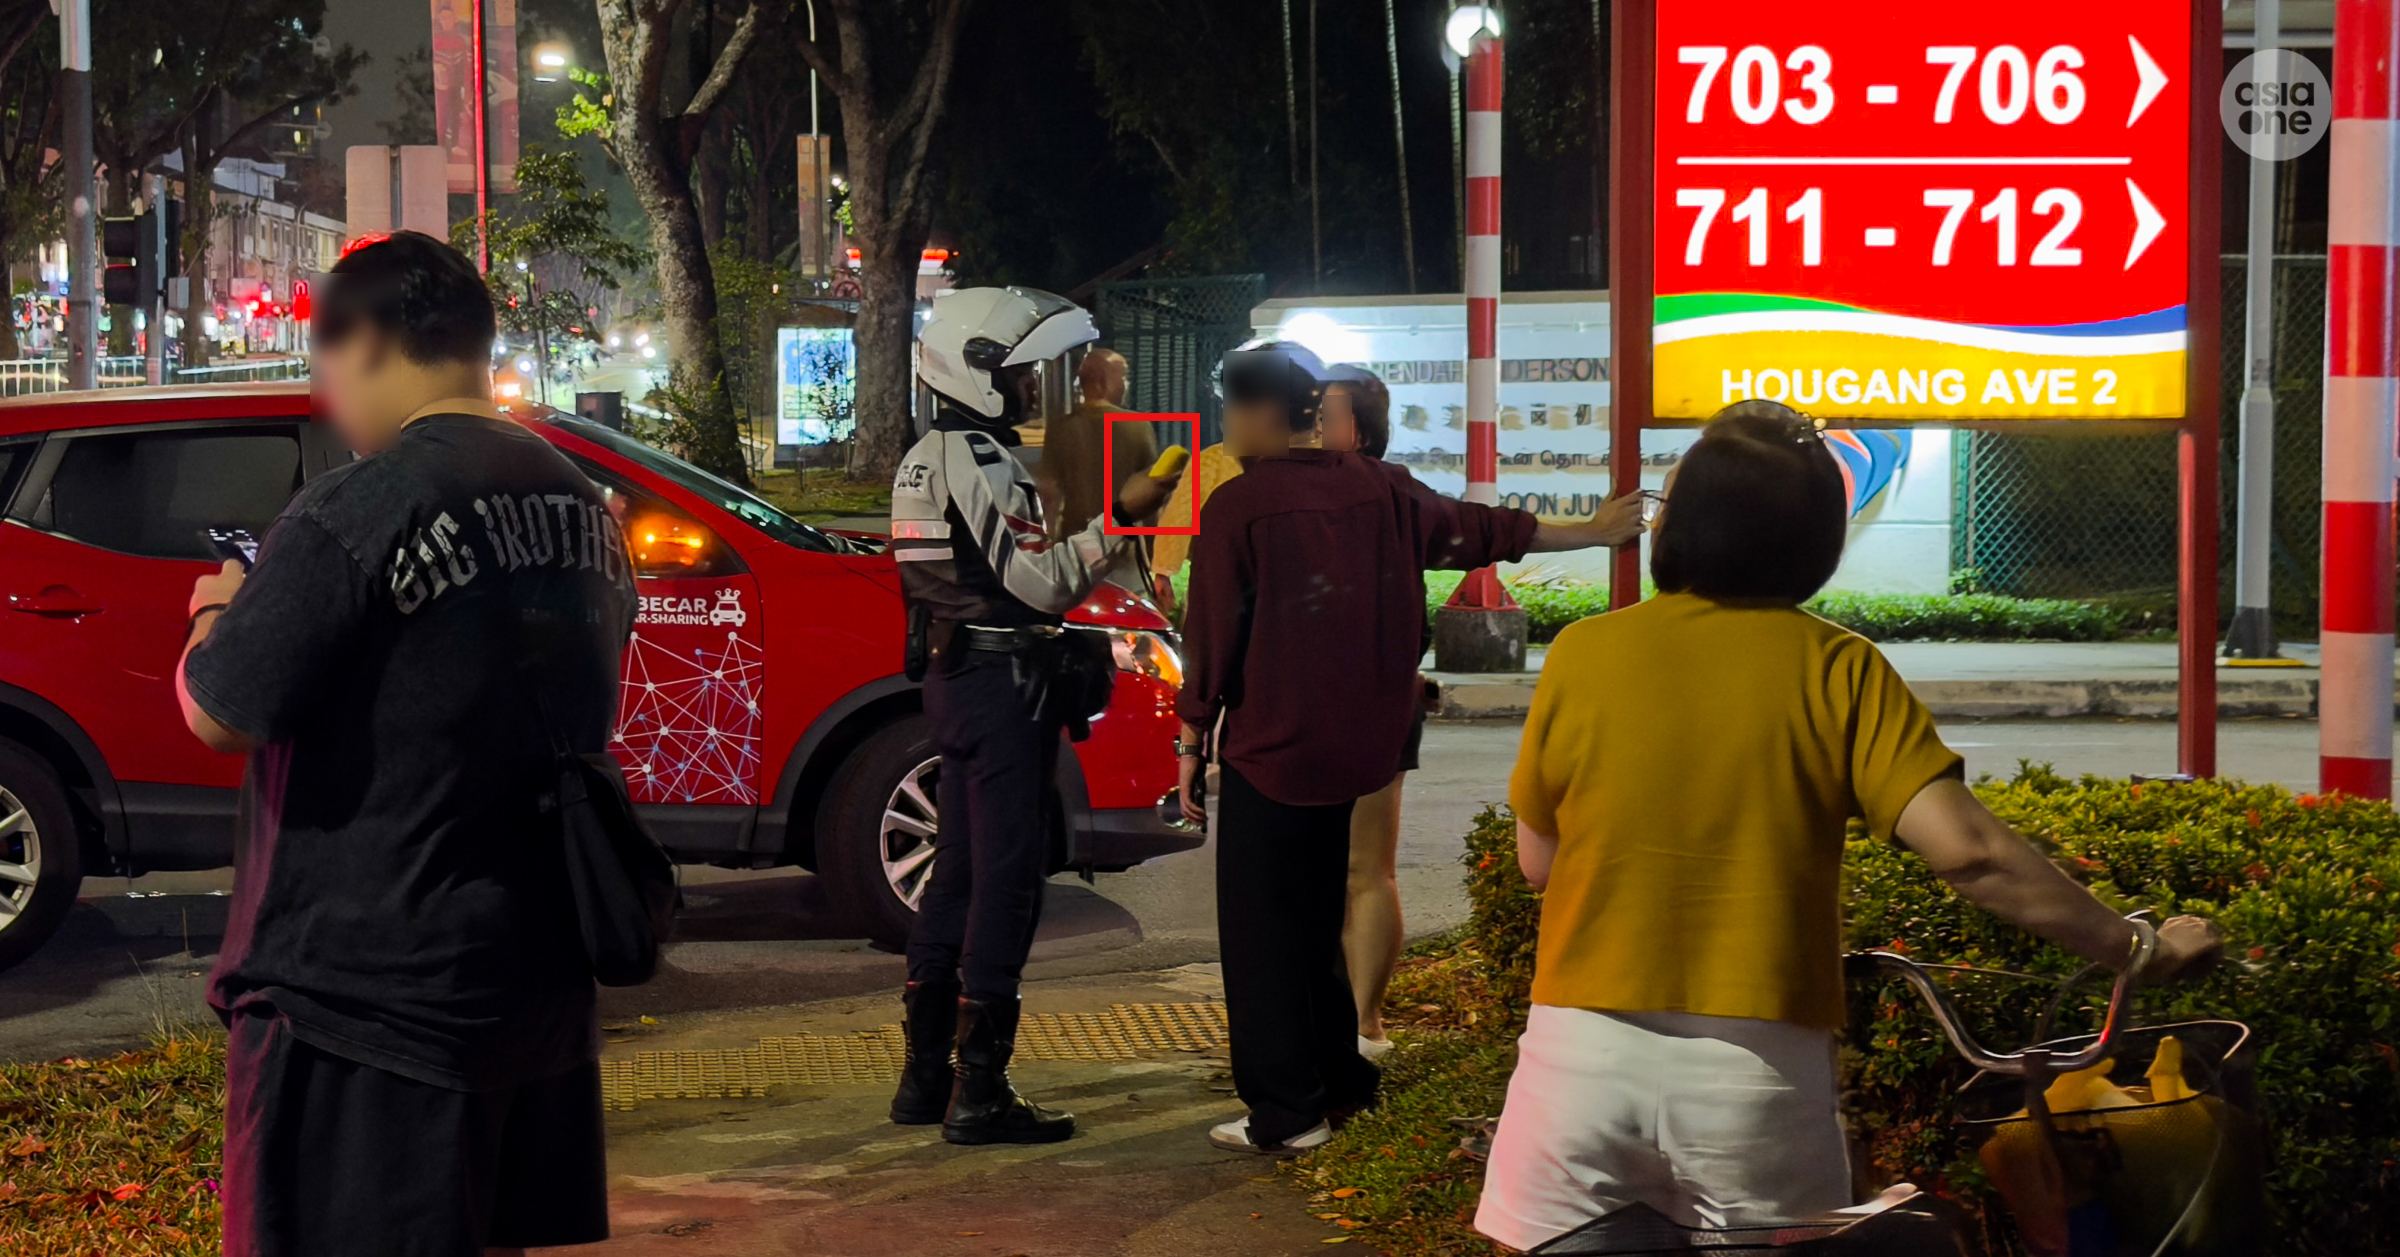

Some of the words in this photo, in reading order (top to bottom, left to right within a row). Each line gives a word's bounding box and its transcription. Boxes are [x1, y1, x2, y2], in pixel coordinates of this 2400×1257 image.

[1678, 45, 1835, 125] 703
[1866, 85, 1898, 104] -
[1925, 44, 2086, 125] 706
[1676, 187, 1822, 267] 711
[1864, 228, 1896, 247] -
[1923, 187, 2083, 267] 712
[1501, 358, 1610, 383] DERSON
[1721, 368, 1967, 406] HOUGANG
[1980, 368, 2078, 405] AVE
[2092, 368, 2118, 405] 2
[1499, 492, 1557, 516] OON
